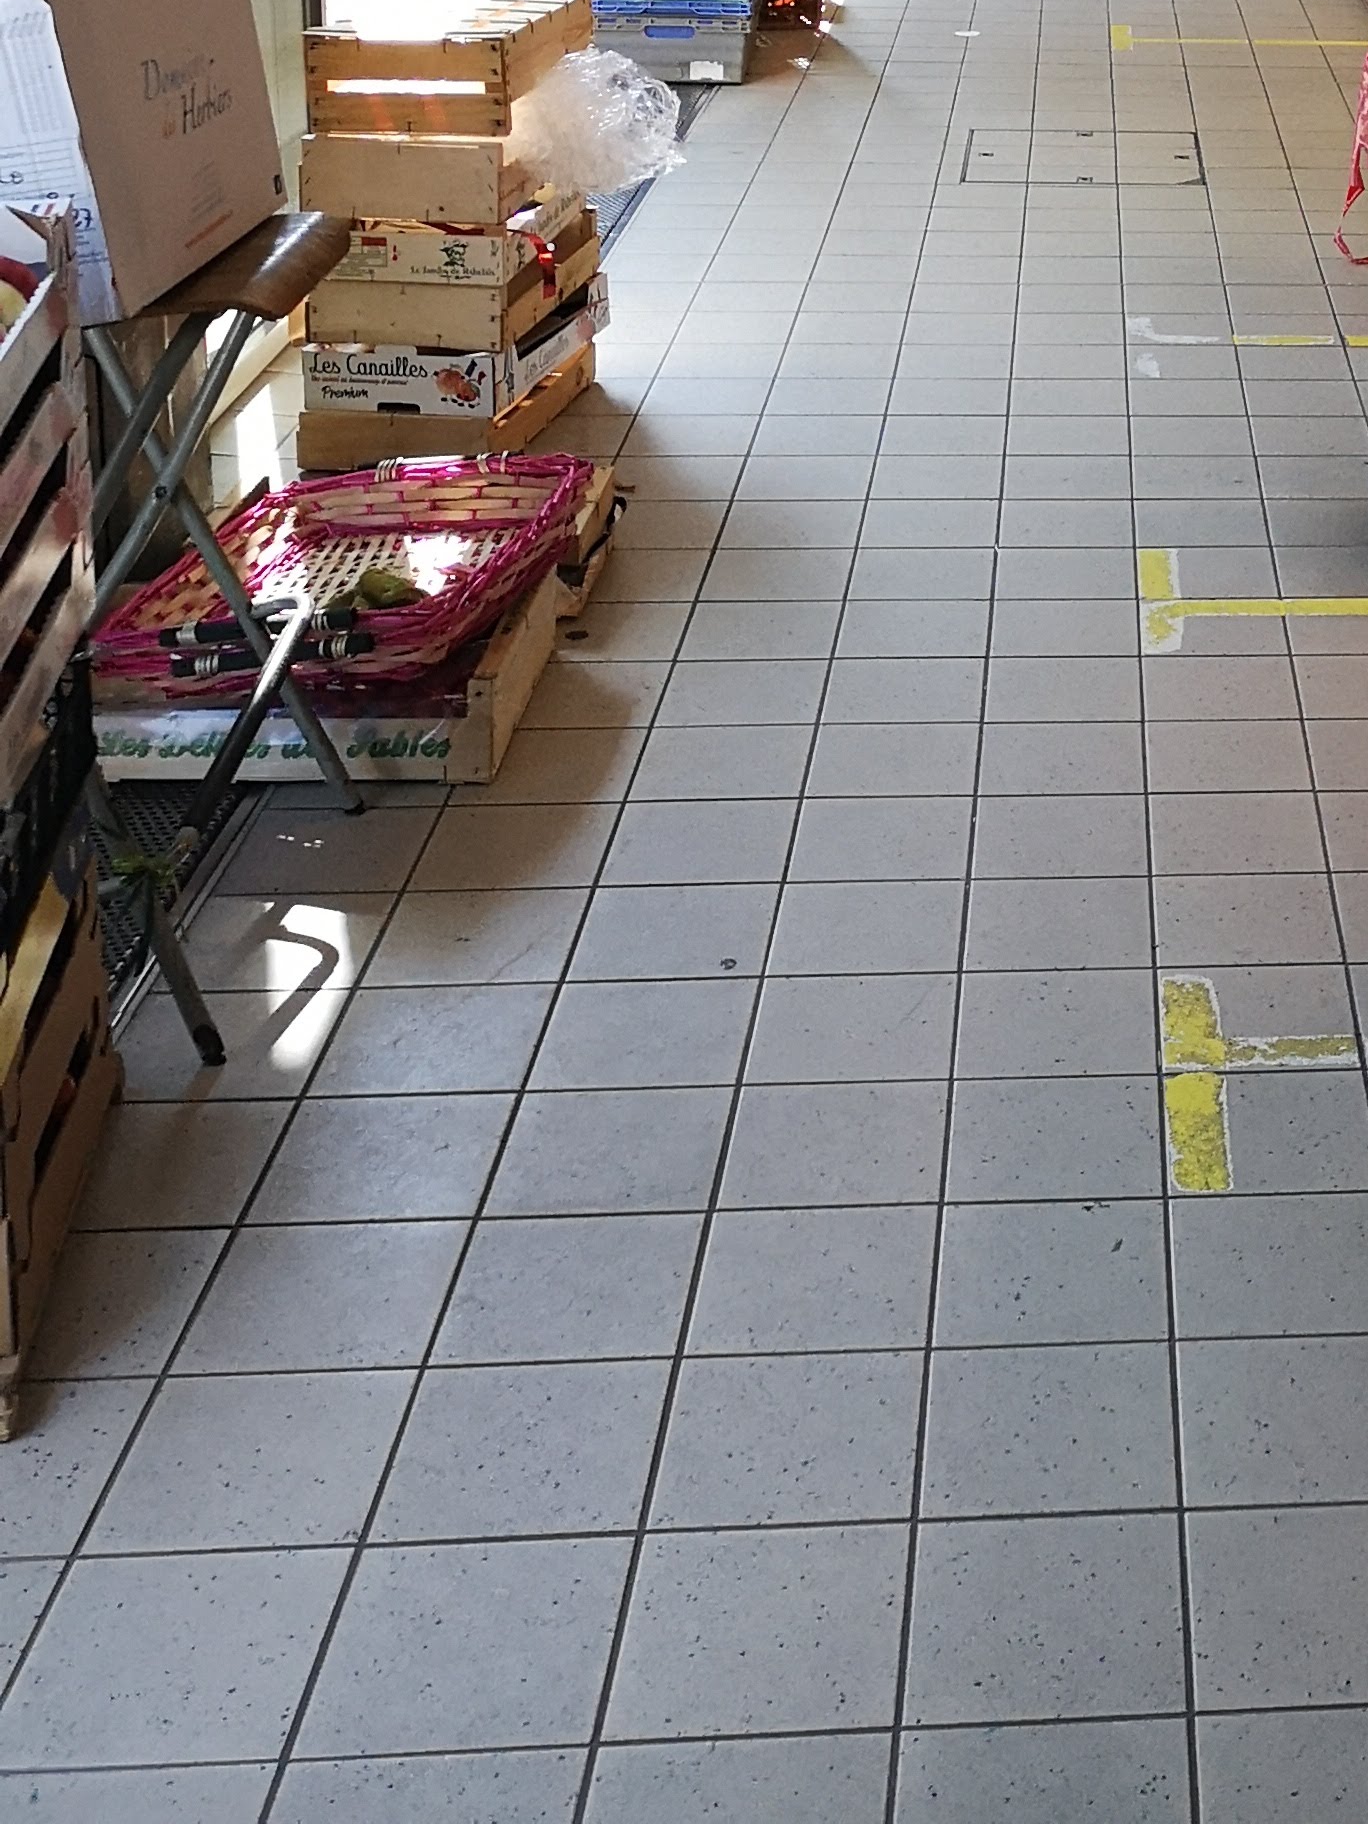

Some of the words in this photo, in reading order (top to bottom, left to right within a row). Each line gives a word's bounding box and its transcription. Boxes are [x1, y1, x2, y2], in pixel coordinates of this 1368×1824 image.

[309, 352, 342, 375] Les
[346, 353, 428, 378] Canailles
[322, 384, 369, 399] Premium
